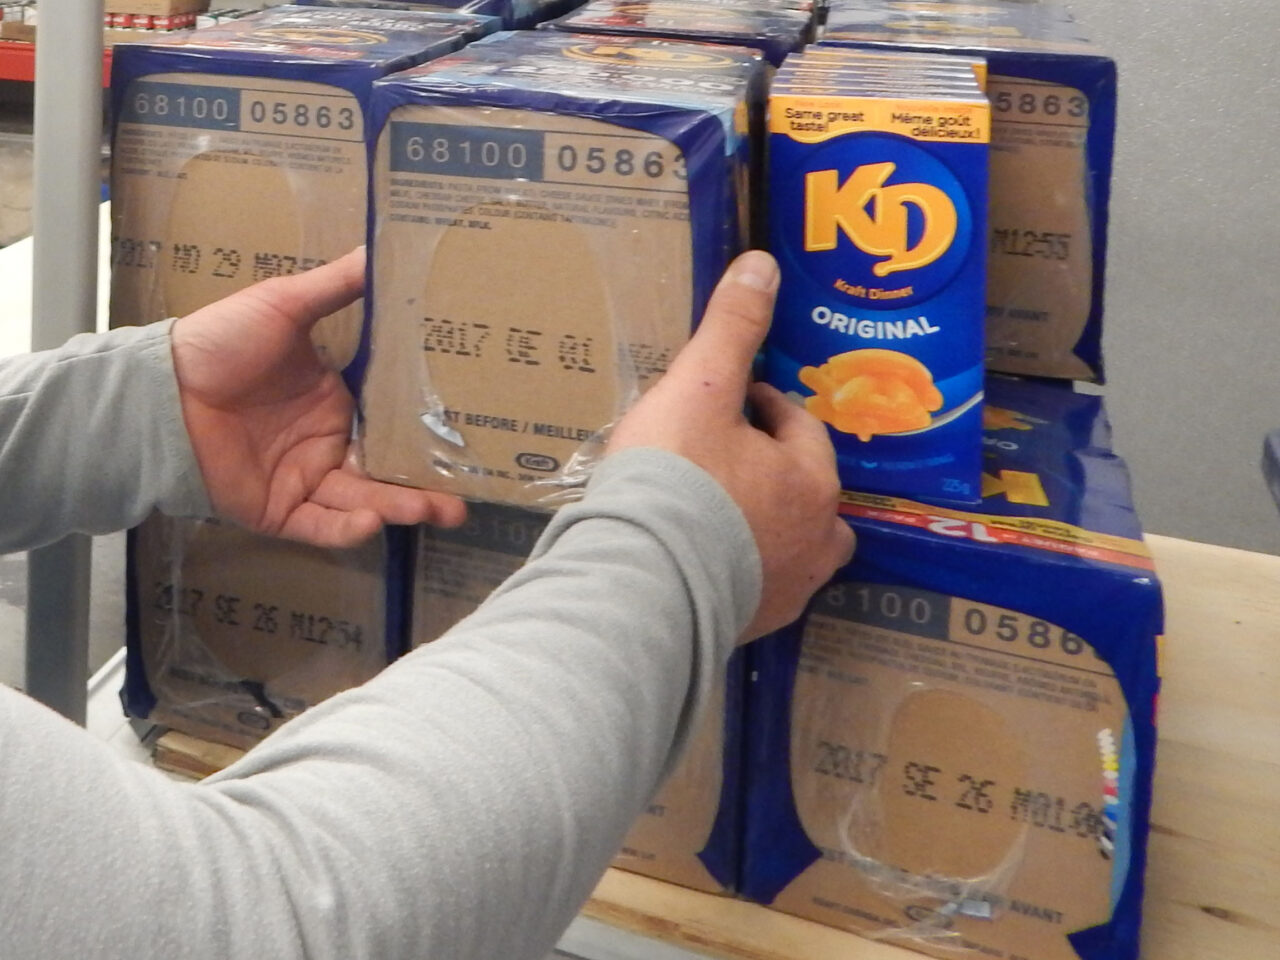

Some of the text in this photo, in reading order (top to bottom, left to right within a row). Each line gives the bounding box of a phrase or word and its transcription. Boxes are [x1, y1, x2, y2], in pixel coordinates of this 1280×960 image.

[134, 92, 354, 131] 68100 05863
[785, 106, 865, 124] Same great
[891, 111, 972, 128] Même goût
[995, 91, 1086, 118] 5863
[790, 121, 829, 133] taste!
[405, 135, 688, 179] 68100 05863
[804, 161, 958, 278] KD
[833, 278, 914, 300] Kraft Dinner
[811, 305, 941, 340] ORIGINAL
[465, 413, 519, 432] BEFORE
[533, 422, 602, 443] MEILLEU
[927, 514, 999, 543] 12
[826, 588, 932, 624] 8100
[964, 607, 1085, 656] 0586
[813, 740, 889, 785] 2017
[901, 760, 943, 802] SE
[954, 773, 996, 815] 26
